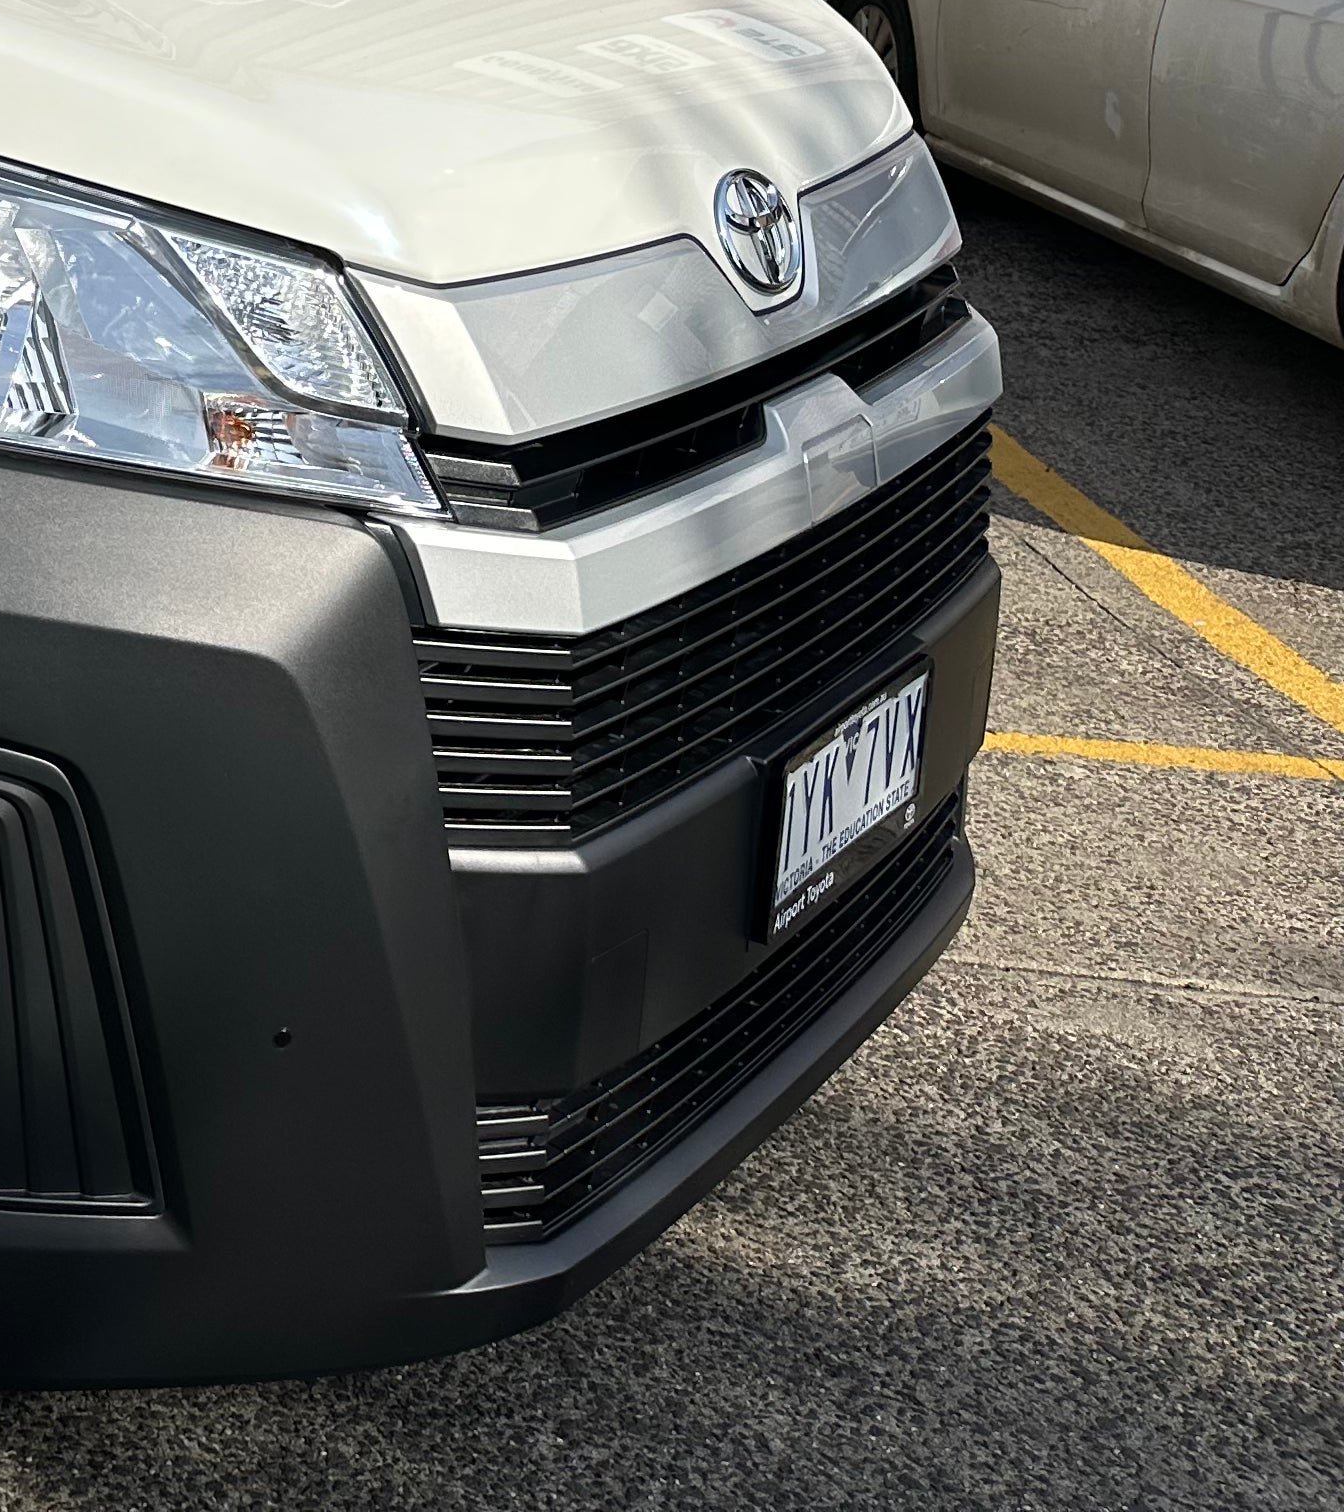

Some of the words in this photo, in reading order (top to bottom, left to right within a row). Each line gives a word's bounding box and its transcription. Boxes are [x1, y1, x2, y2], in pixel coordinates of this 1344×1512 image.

[776, 856, 813, 902] VICTORIA
[821, 835, 838, 863] THE
[838, 798, 885, 848] EDUCATION
[885, 780, 910, 812] STATE
[783, 746, 840, 873] 1YK
[864, 687, 923, 806] 7VX
[772, 892, 806, 935] Airport
[806, 871, 835, 904] Toyota
